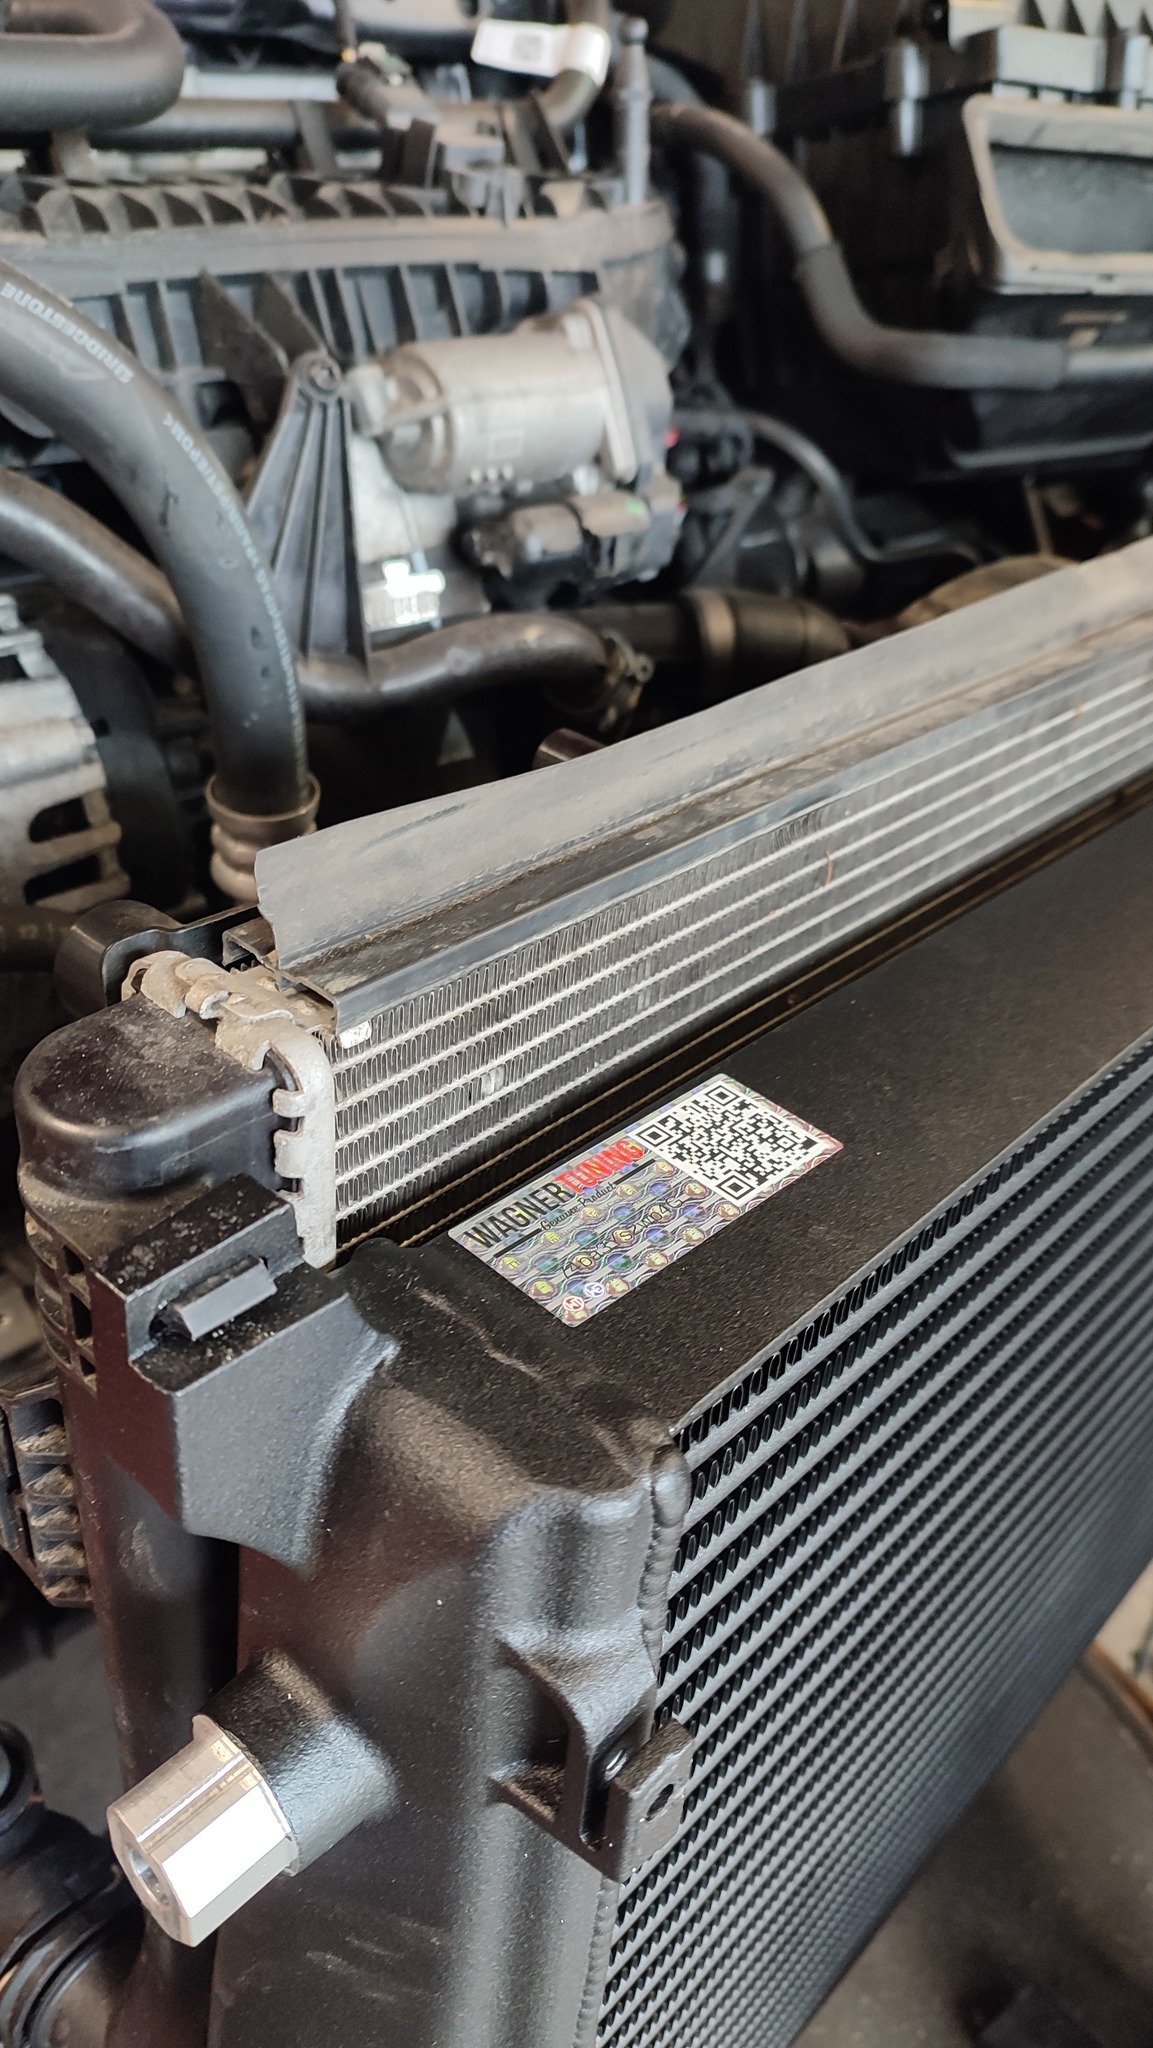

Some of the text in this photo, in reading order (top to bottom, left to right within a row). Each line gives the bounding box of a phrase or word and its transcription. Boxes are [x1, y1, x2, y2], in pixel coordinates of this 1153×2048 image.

[0, 282, 134, 384] BRIDGESTONE
[540, 1181, 617, 1231] Genuine Product
